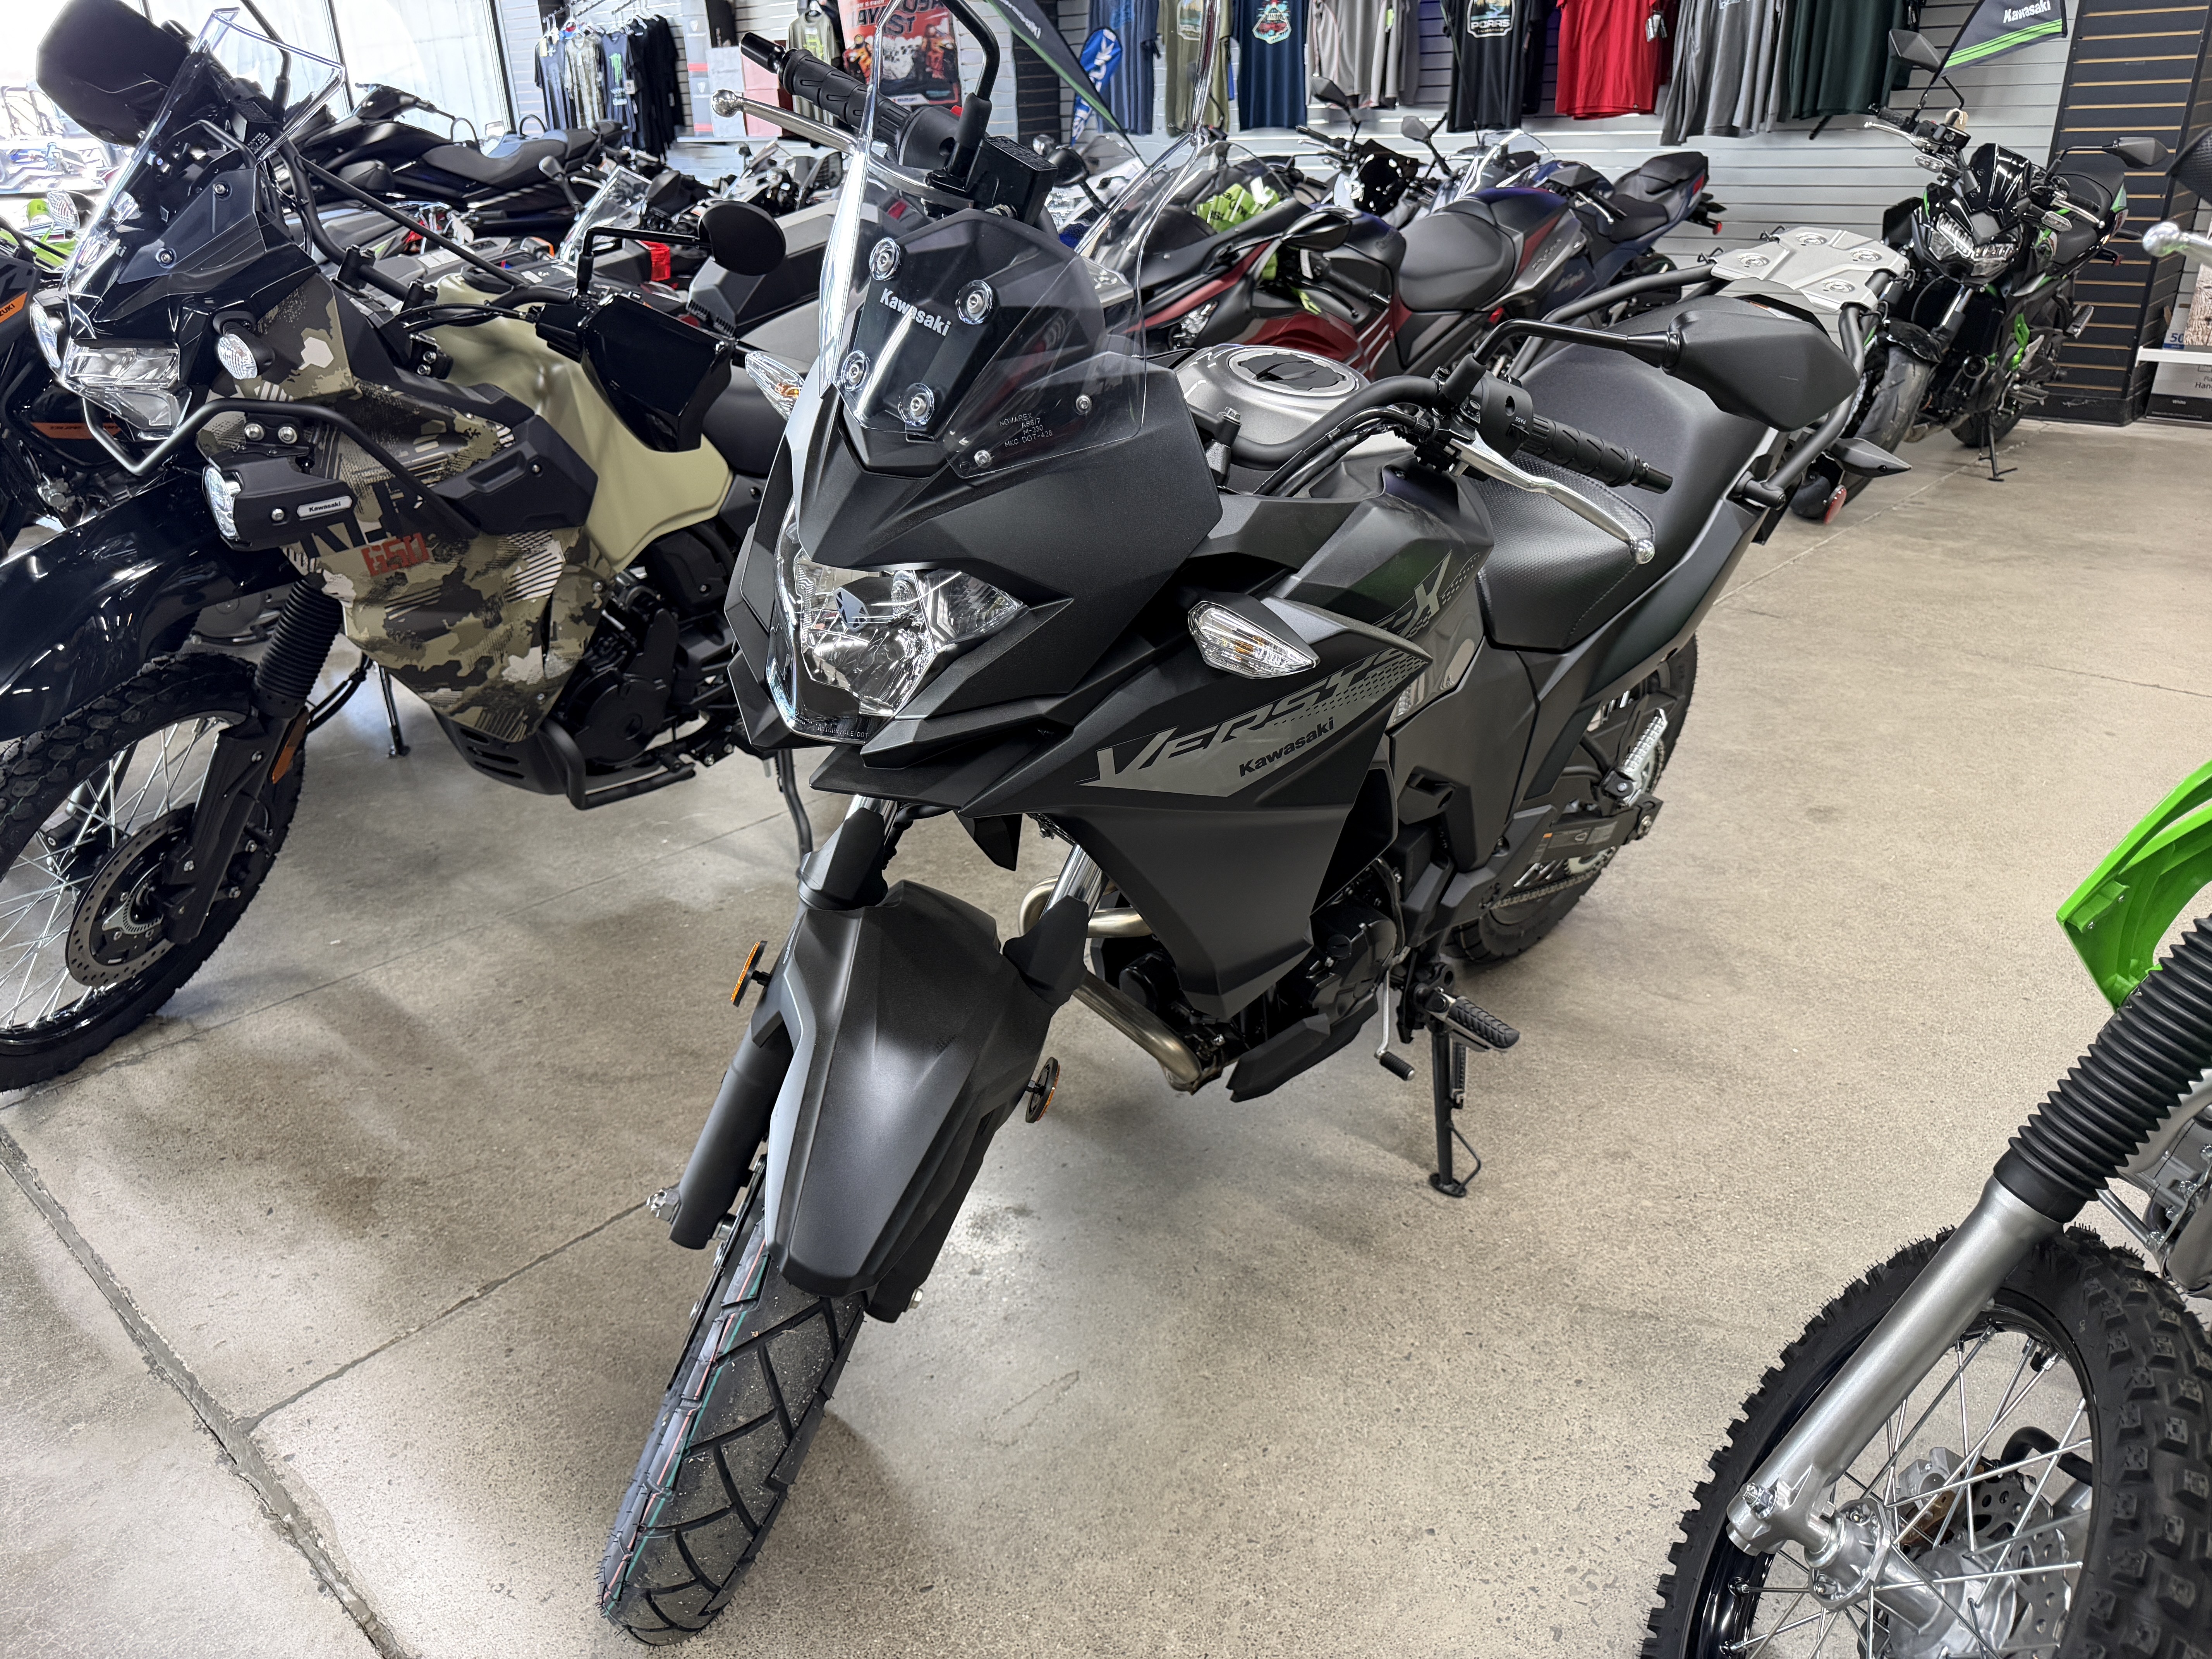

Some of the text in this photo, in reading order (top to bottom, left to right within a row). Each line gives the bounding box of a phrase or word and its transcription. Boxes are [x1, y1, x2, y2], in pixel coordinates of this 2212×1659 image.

[2003, 0, 2051, 23] Kawasaki
[880, 288, 951, 337] Kawasaki
[999, 412, 1033, 426] NOVAREX
[1515, 416, 1526, 425] PASS
[1022, 430, 1053, 443] DOT-428
[1023, 425, 1044, 435] M-230
[309, 501, 341, 512] Kawasaki
[361, 532, 430, 577] 650
[1239, 716, 1335, 777] Kawasaki
